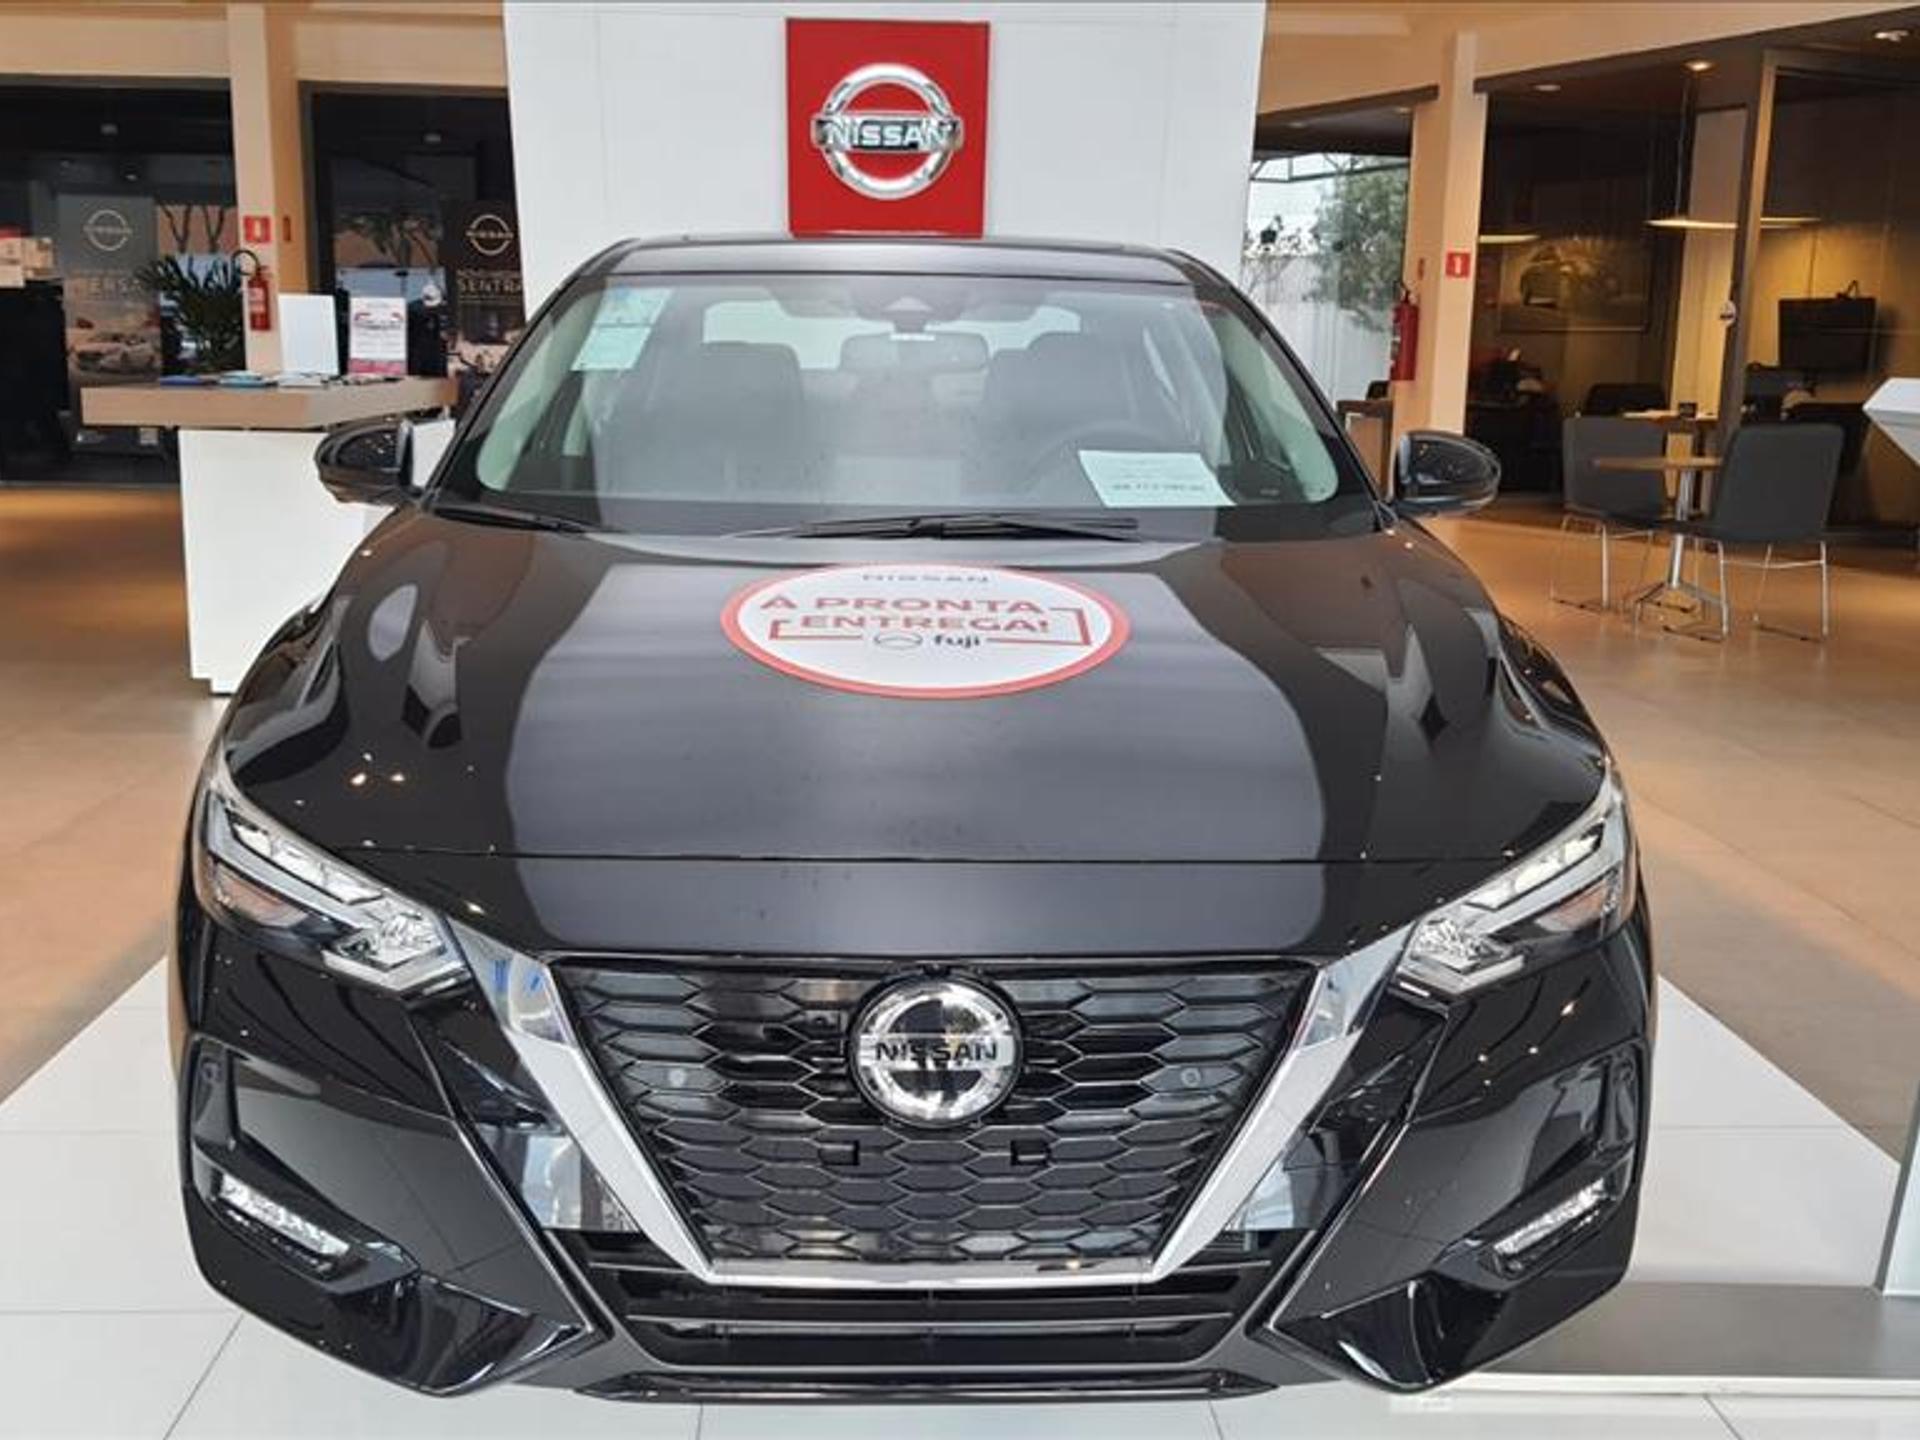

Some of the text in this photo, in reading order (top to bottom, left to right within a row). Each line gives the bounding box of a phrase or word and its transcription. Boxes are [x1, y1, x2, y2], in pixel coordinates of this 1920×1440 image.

[827, 121, 947, 146] NISSAN
[862, 573, 989, 583] NISSAN
[815, 598, 1044, 614] PRONTA
[802, 615, 1049, 633] ENTREGA!
[934, 634, 981, 648] fuji
[876, 1041, 998, 1062] NISSAN
